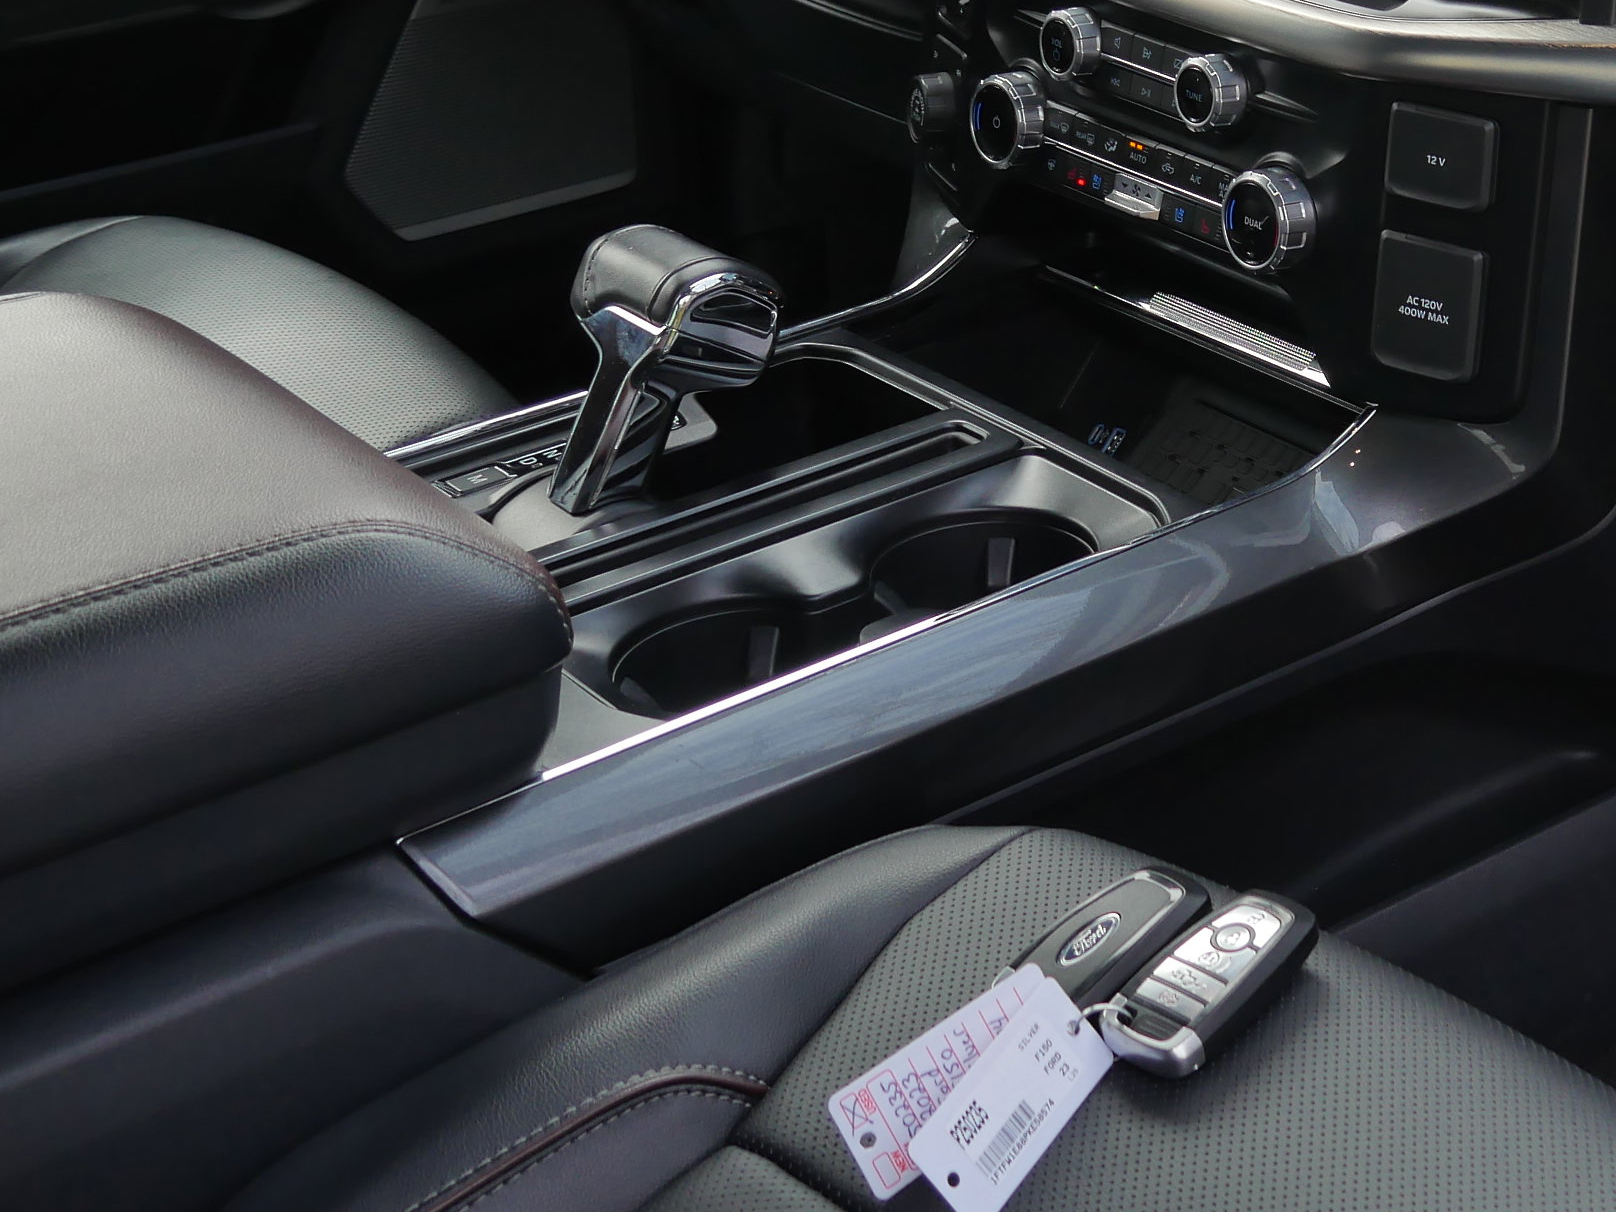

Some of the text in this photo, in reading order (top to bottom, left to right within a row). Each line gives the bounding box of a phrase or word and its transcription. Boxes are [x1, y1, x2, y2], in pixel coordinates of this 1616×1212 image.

[1185, 89, 1203, 103] TUNE
[1129, 151, 1147, 165] AUTO
[1426, 154, 1446, 167] 12 V
[1190, 173, 1202, 185] A/C
[1243, 216, 1263, 231] DUAL
[1406, 295, 1443, 312] AC 120V
[1398, 305, 1450, 325] 400W MAX
[519, 456, 537, 466] D
[1072, 922, 1107, 958] Ford
[1018, 1022, 1041, 1052] SILVER
[1034, 1038, 1054, 1062] F150
[1043, 1051, 1062, 1076] FORD
[1058, 1063, 1071, 1078] 23
[858, 1088, 877, 1116] USED
[949, 1099, 990, 1151] P250235
[891, 1150, 908, 1174] NEW
